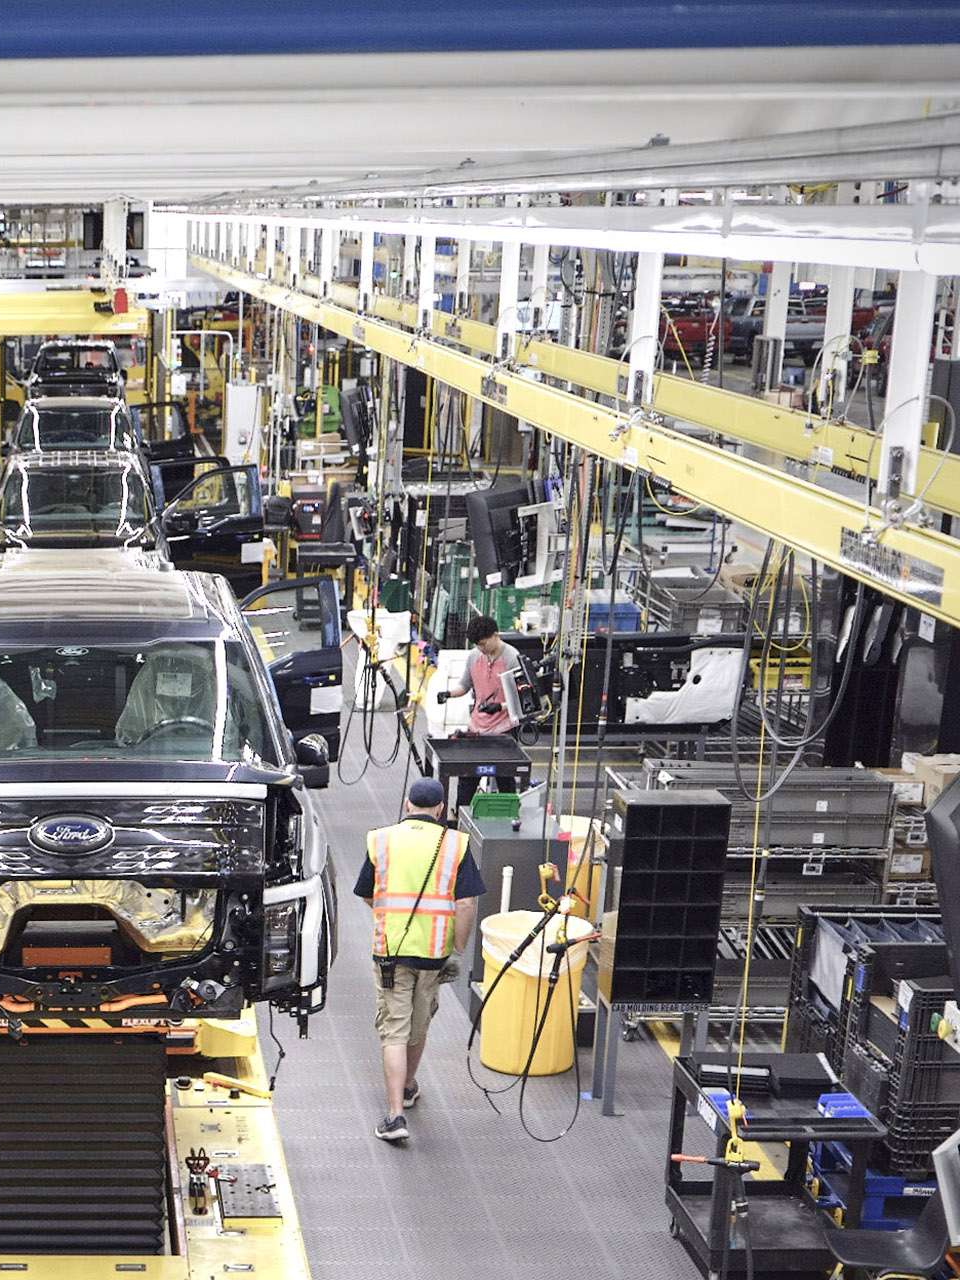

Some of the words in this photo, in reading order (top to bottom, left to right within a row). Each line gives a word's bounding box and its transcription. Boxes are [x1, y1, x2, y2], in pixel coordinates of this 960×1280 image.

[612, 1003, 627, 1012] CAB
[627, 1003, 659, 1012] MOLDING
[660, 1003, 680, 1012] REAR
[680, 1003, 709, 1012] CORNER
[121, 1018, 167, 1027] FLEXLIFT
